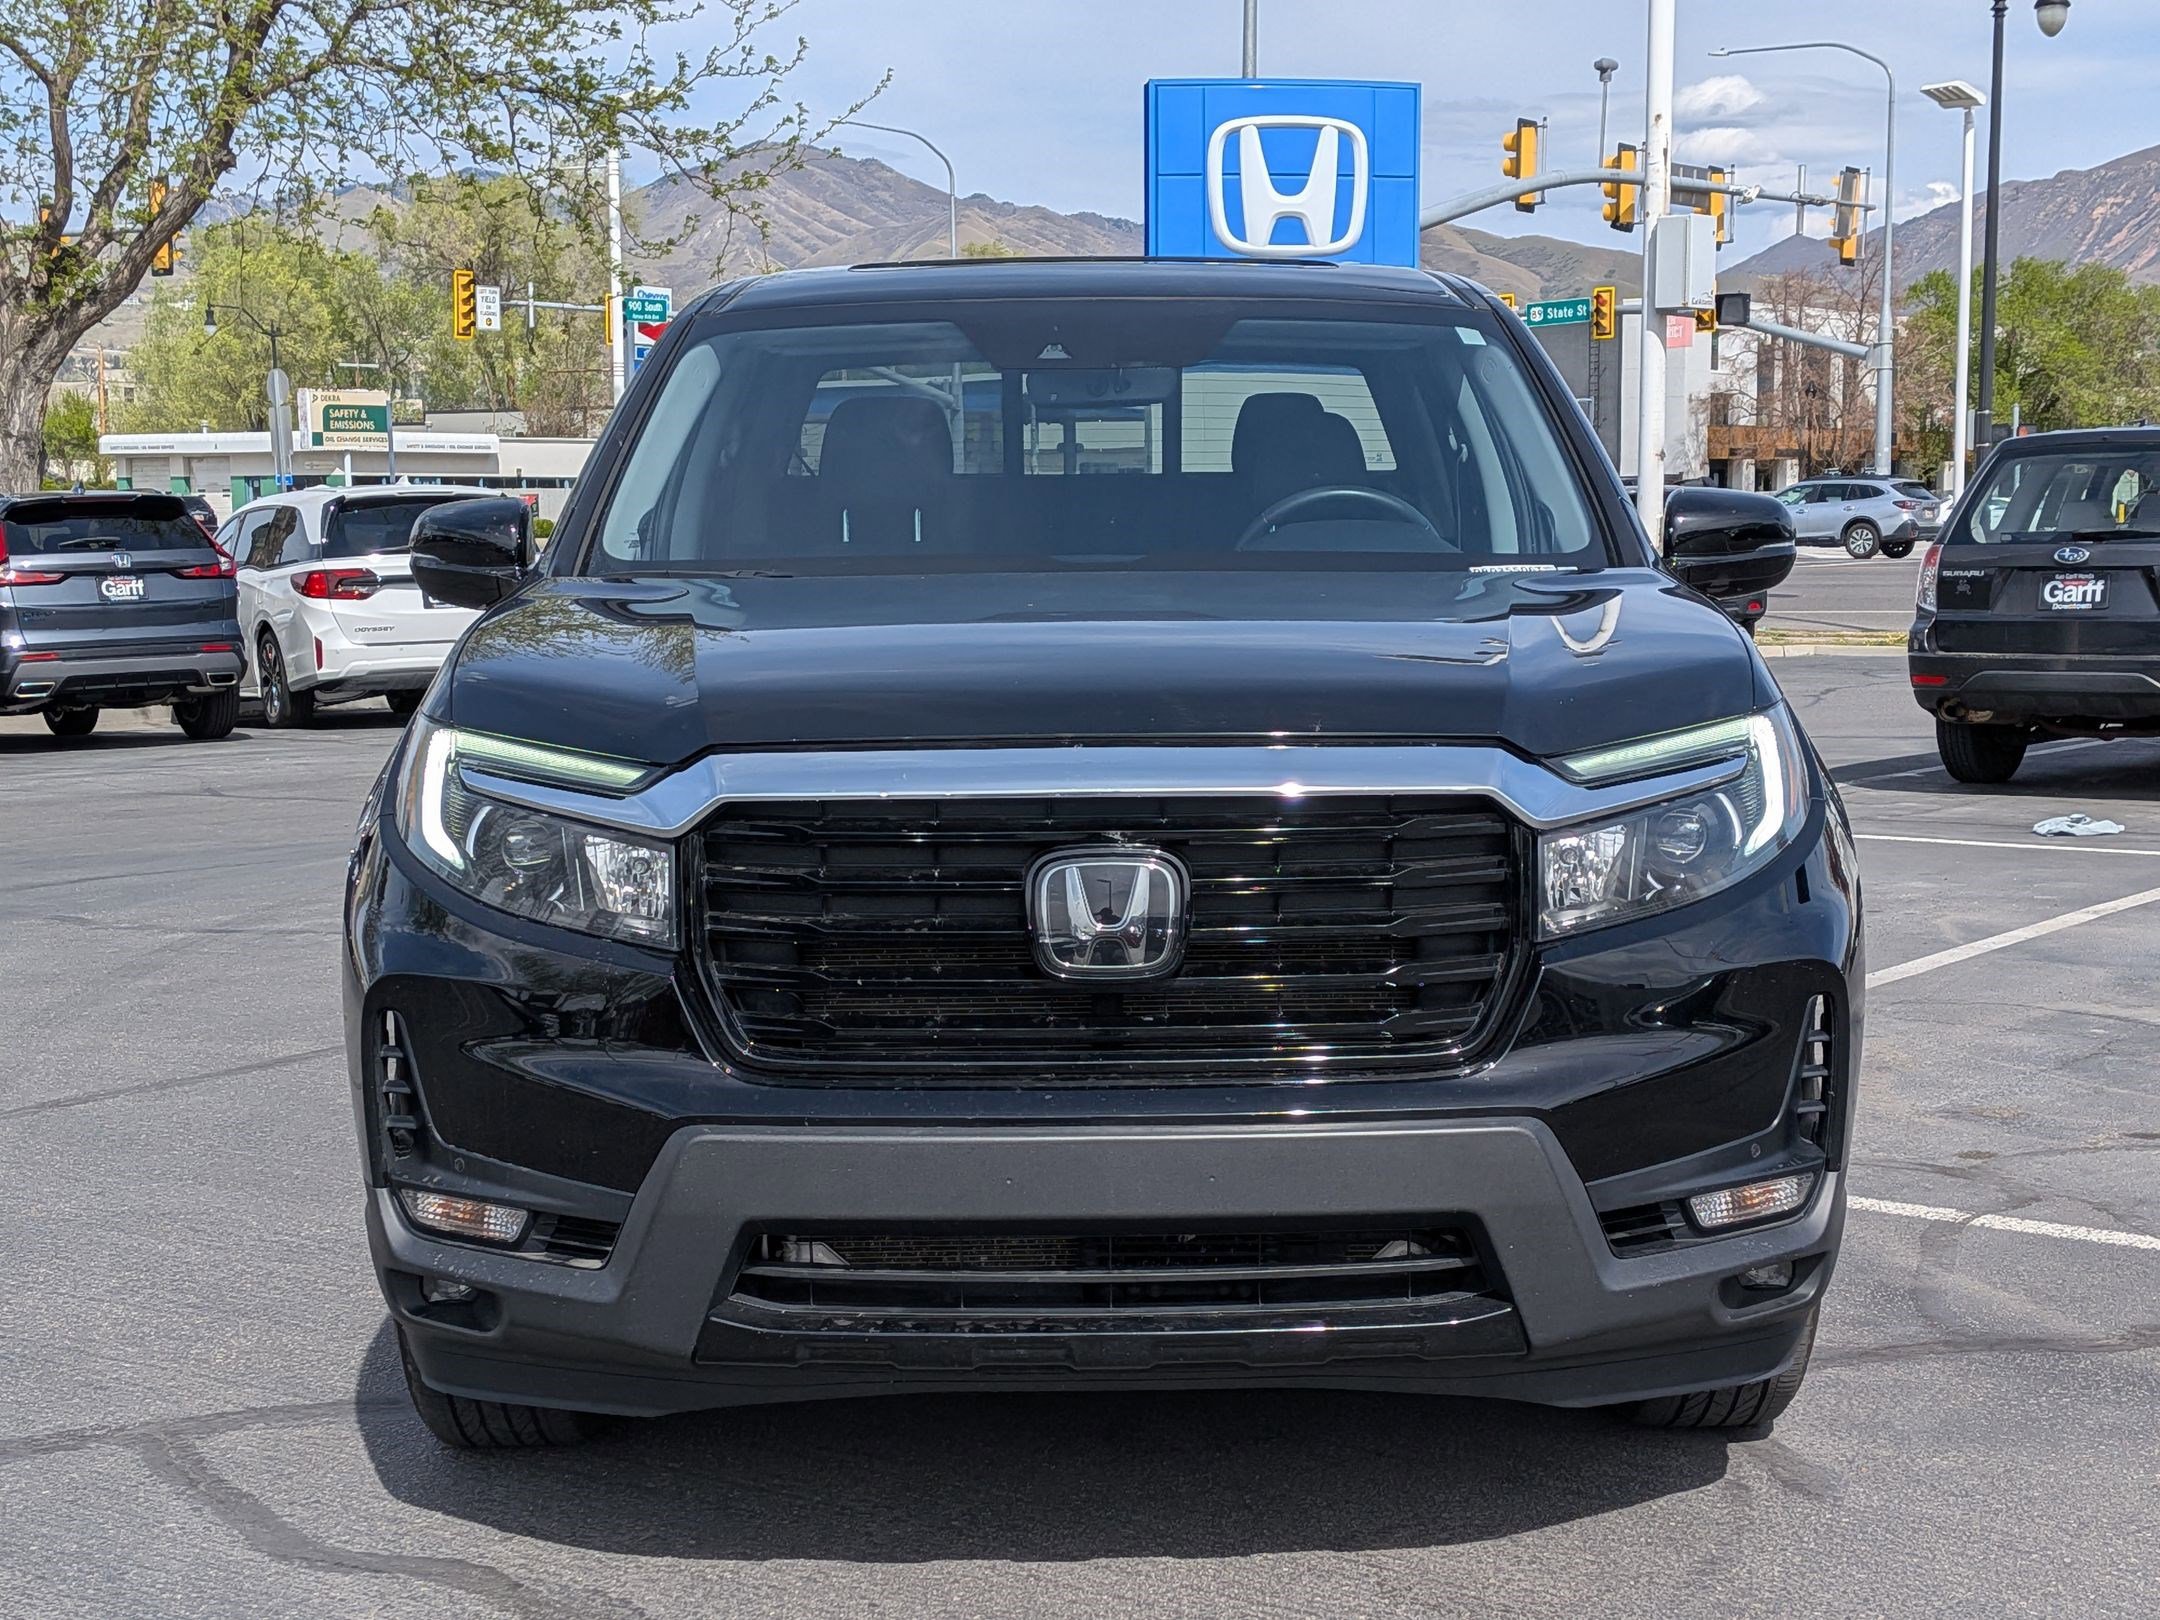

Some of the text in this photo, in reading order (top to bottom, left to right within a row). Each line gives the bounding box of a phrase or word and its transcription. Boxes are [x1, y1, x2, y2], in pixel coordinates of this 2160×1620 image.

[628, 301, 663, 312] 900 South
[1547, 306, 1574, 319] State
[1577, 304, 1587, 316] St
[320, 394, 341, 402] DEKRA
[329, 408, 367, 419] SAFETY &
[330, 420, 376, 430] EMISSIONS
[101, 580, 145, 596] Garff
[2044, 580, 2105, 603] Garff
